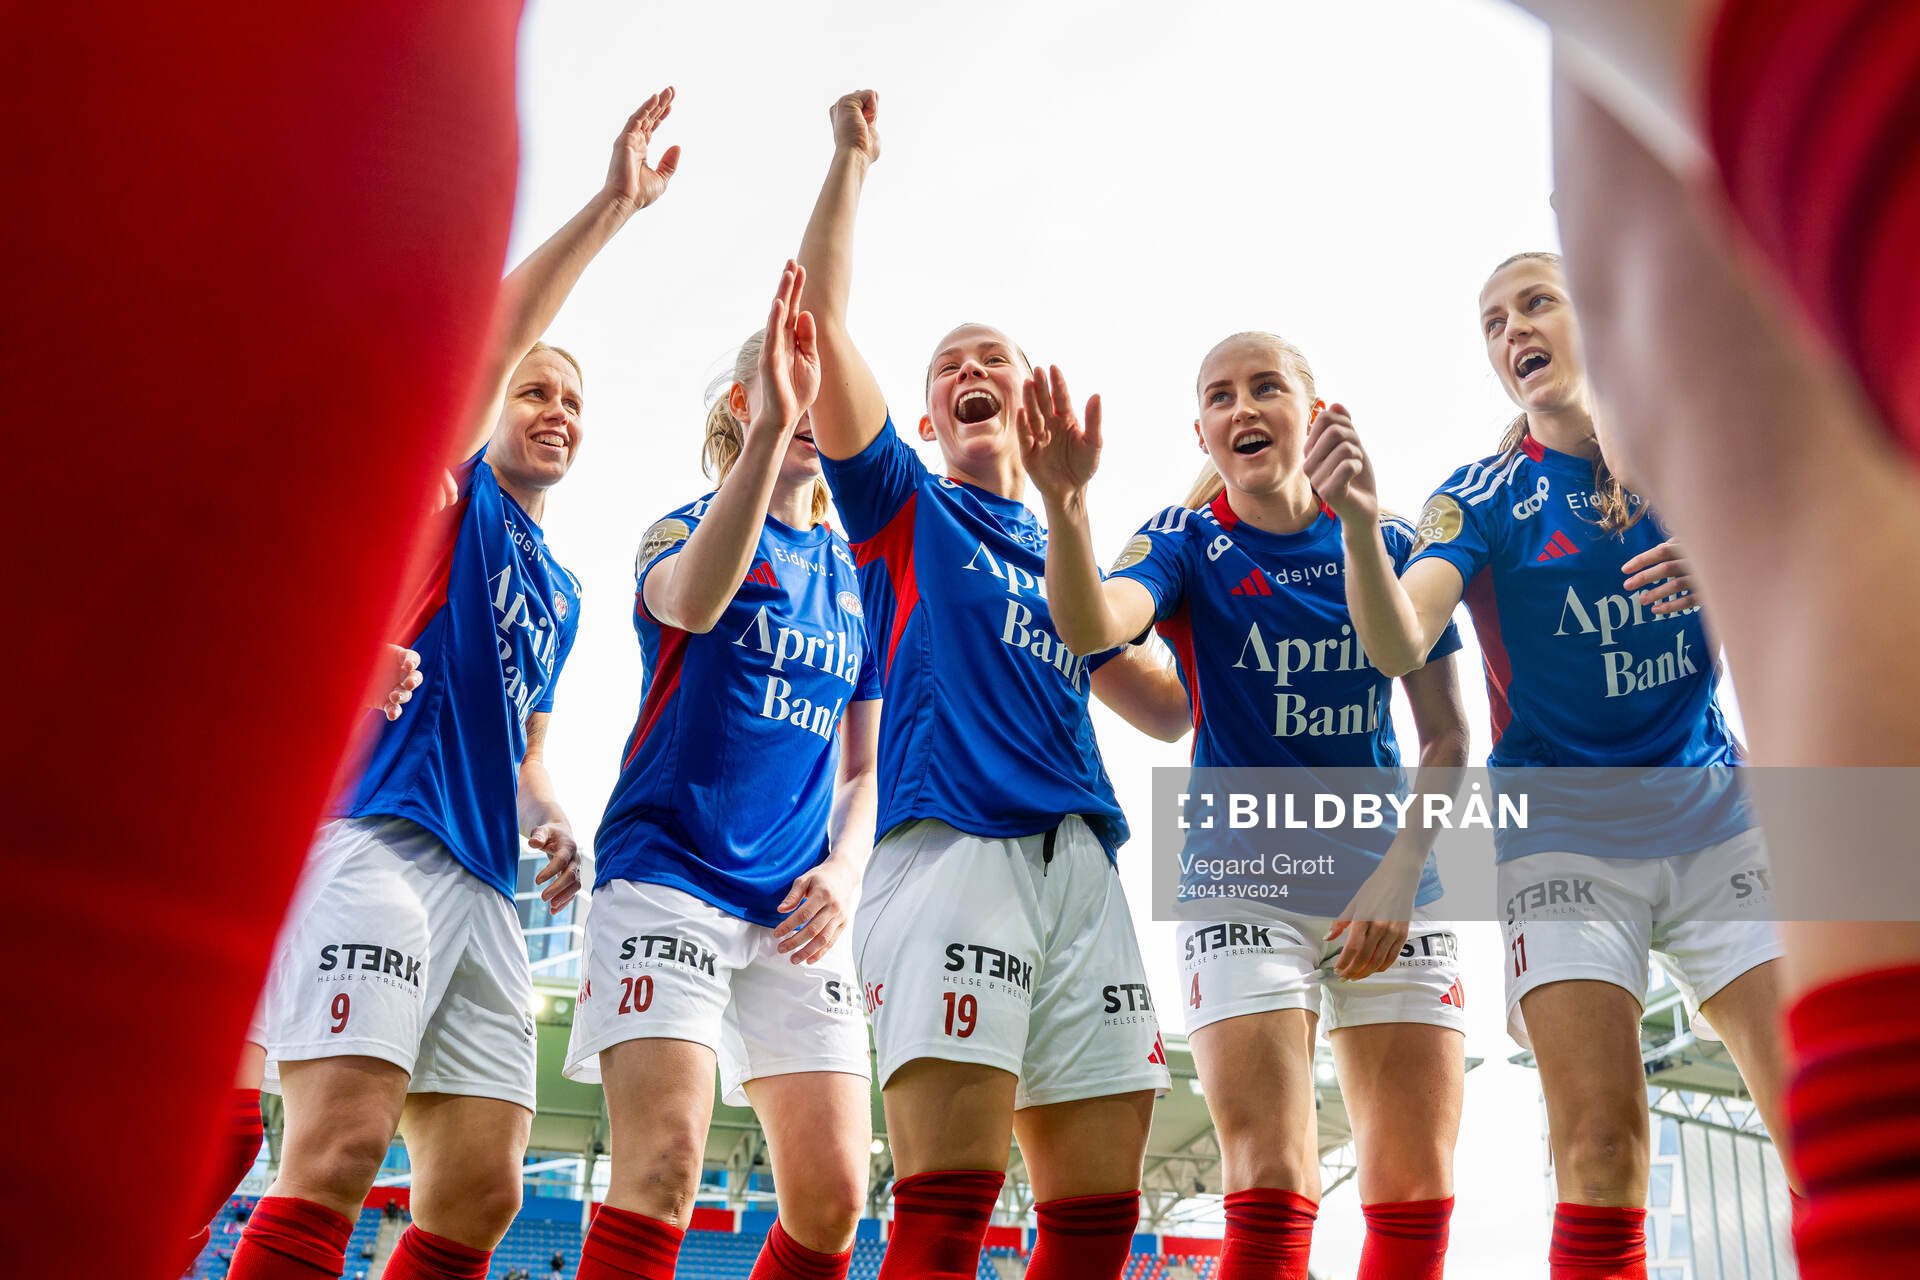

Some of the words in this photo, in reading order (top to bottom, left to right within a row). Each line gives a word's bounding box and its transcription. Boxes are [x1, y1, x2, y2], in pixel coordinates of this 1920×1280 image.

[732, 605, 859, 687] Aprila
[1232, 621, 1376, 687] April
[1601, 629, 1698, 698] Bank
[1511, 932, 1527, 978] 11
[317, 973, 353, 984] HELSE
[618, 975, 654, 1016] 20
[943, 976, 982, 988] HELSE
[1189, 972, 1203, 1009] 4
[330, 992, 351, 1034] 9
[943, 991, 978, 1039] 19
